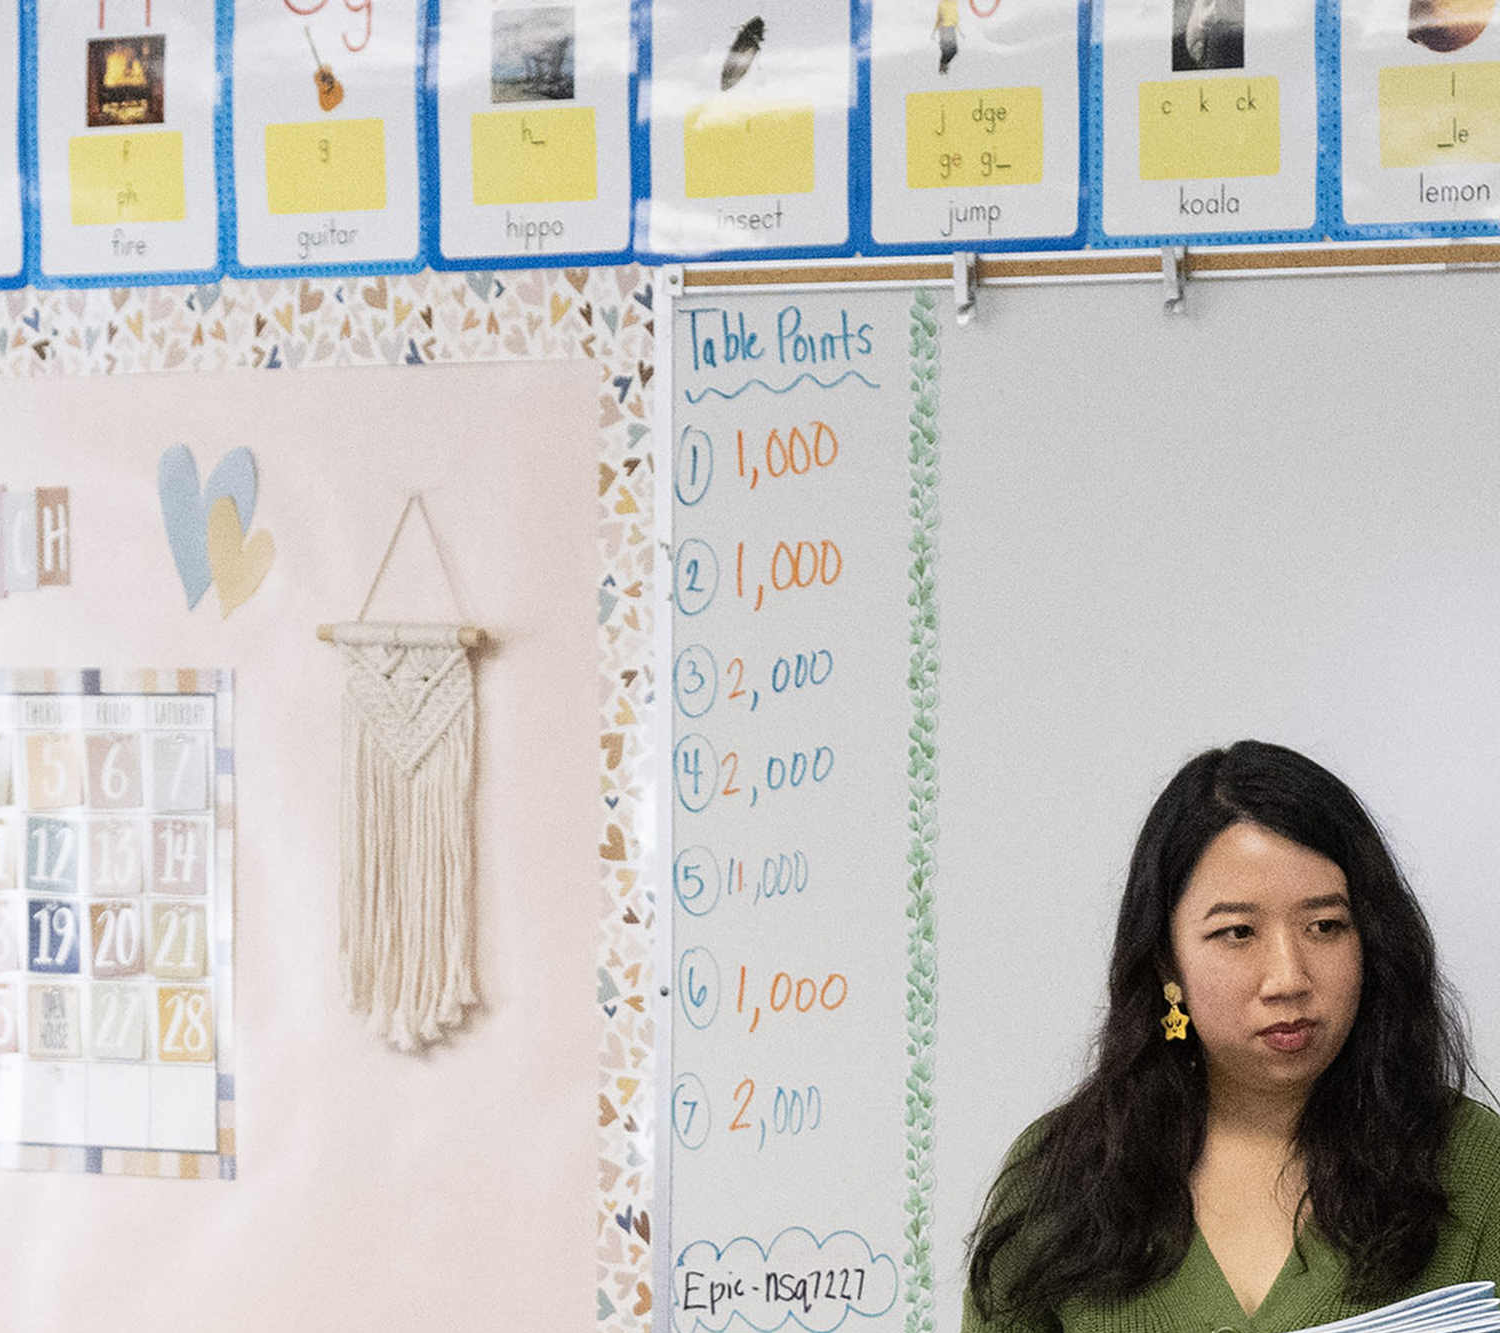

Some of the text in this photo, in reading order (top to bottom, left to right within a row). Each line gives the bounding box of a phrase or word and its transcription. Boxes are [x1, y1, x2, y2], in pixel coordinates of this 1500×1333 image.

[972, 98, 1007, 135] dge
[1161, 84, 1258, 115] c k ck
[939, 152, 962, 179] ge
[1418, 174, 1491, 204] lemon
[716, 201, 784, 231] insect
[940, 201, 1001, 236] jump
[1179, 185, 1241, 216] koala
[111, 228, 147, 256] fire
[297, 219, 358, 259] guitar
[506, 211, 565, 251] hippo
[678, 305, 874, 371] Table Points
[736, 421, 839, 490] 1,000
[736, 539, 843, 612] 1,000
[726, 649, 834, 712] 2,000
[42, 743, 66, 797] 5
[102, 742, 127, 798] 6
[720, 745, 835, 808] 2,000
[32, 827, 74, 881] 12
[158, 828, 196, 882] 14
[33, 906, 76, 965] 19
[94, 907, 138, 967] 20
[155, 909, 198, 968] 21
[97, 991, 142, 1048] 27
[163, 995, 207, 1051] 28
[736, 965, 848, 1033] 1,000
[729, 1078, 822, 1153] 2,000
